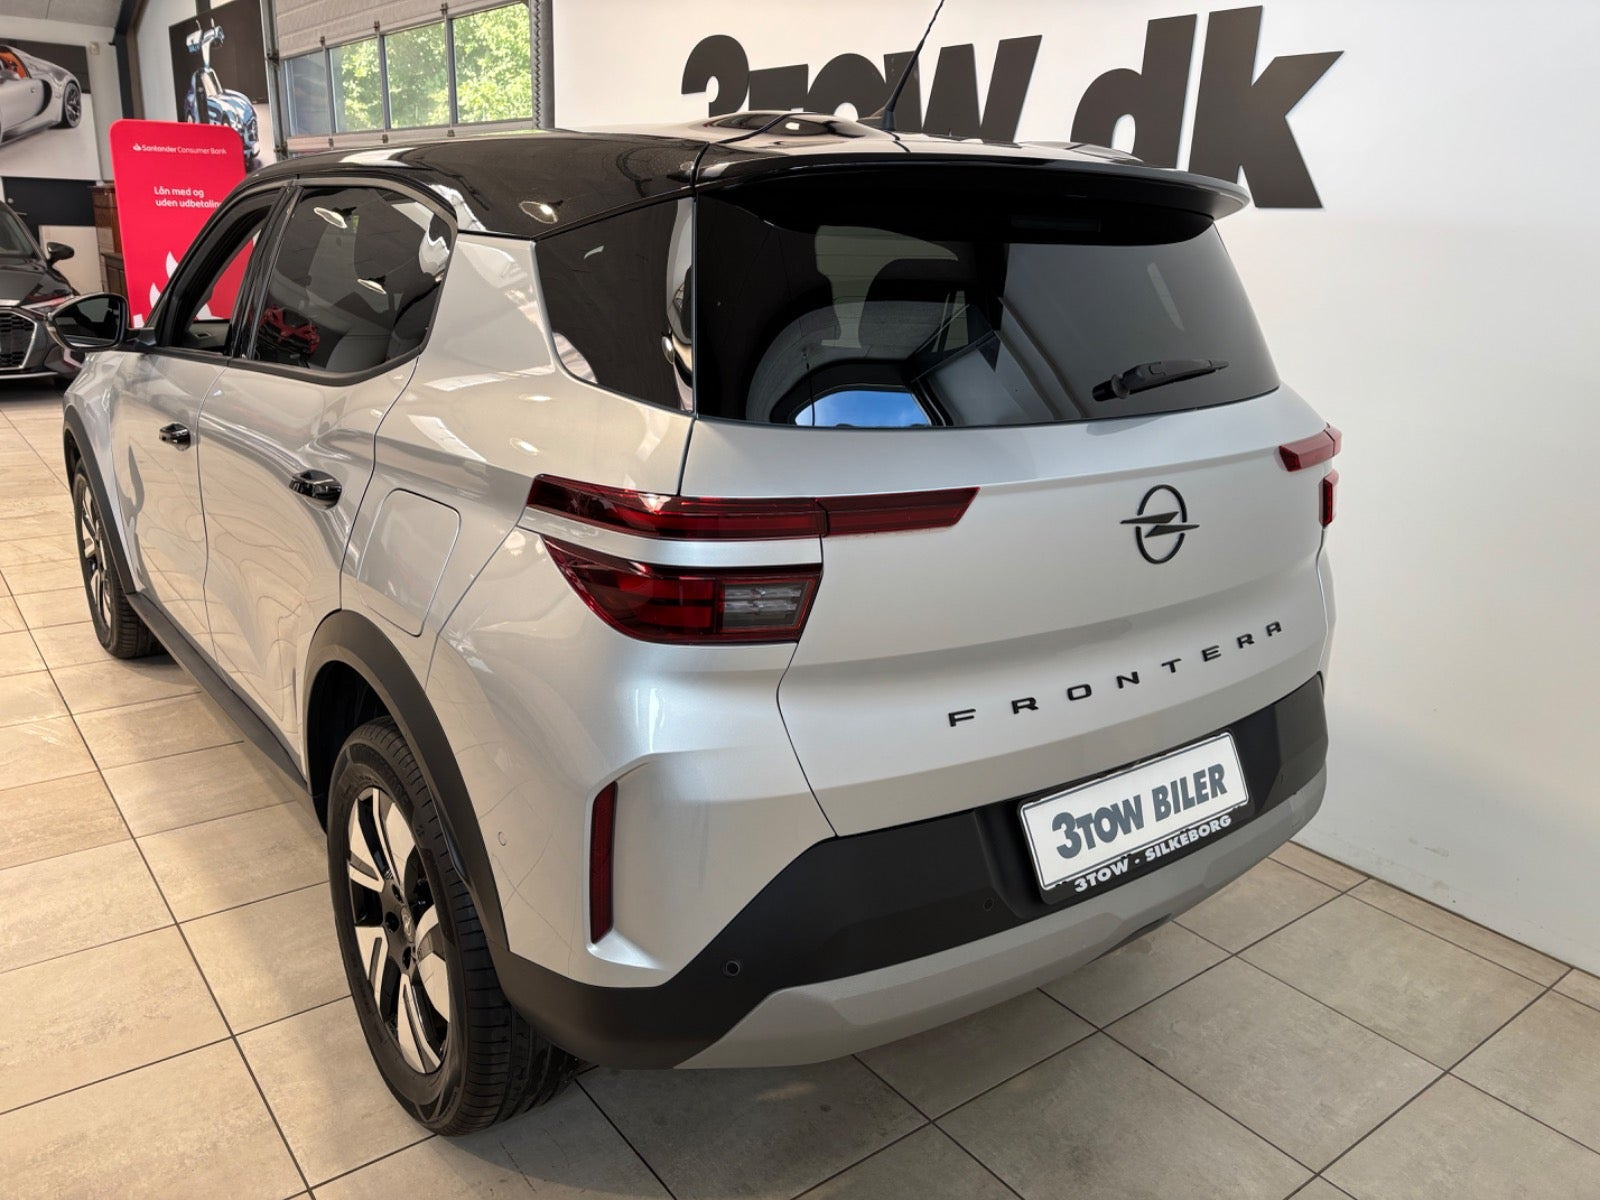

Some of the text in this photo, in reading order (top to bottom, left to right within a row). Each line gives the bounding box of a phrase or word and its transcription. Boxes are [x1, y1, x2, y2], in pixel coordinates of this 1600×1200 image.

[141, 144, 227, 155] Santander Consumer Bank
[153, 186, 204, 198] Lån med og
[155, 199, 221, 208] uden udbetalin
[948, 621, 1282, 727] FRONTERA
[1052, 763, 1228, 859] 3TOW BILER
[1074, 814, 1232, 892] 3TOW SILKEBORG
